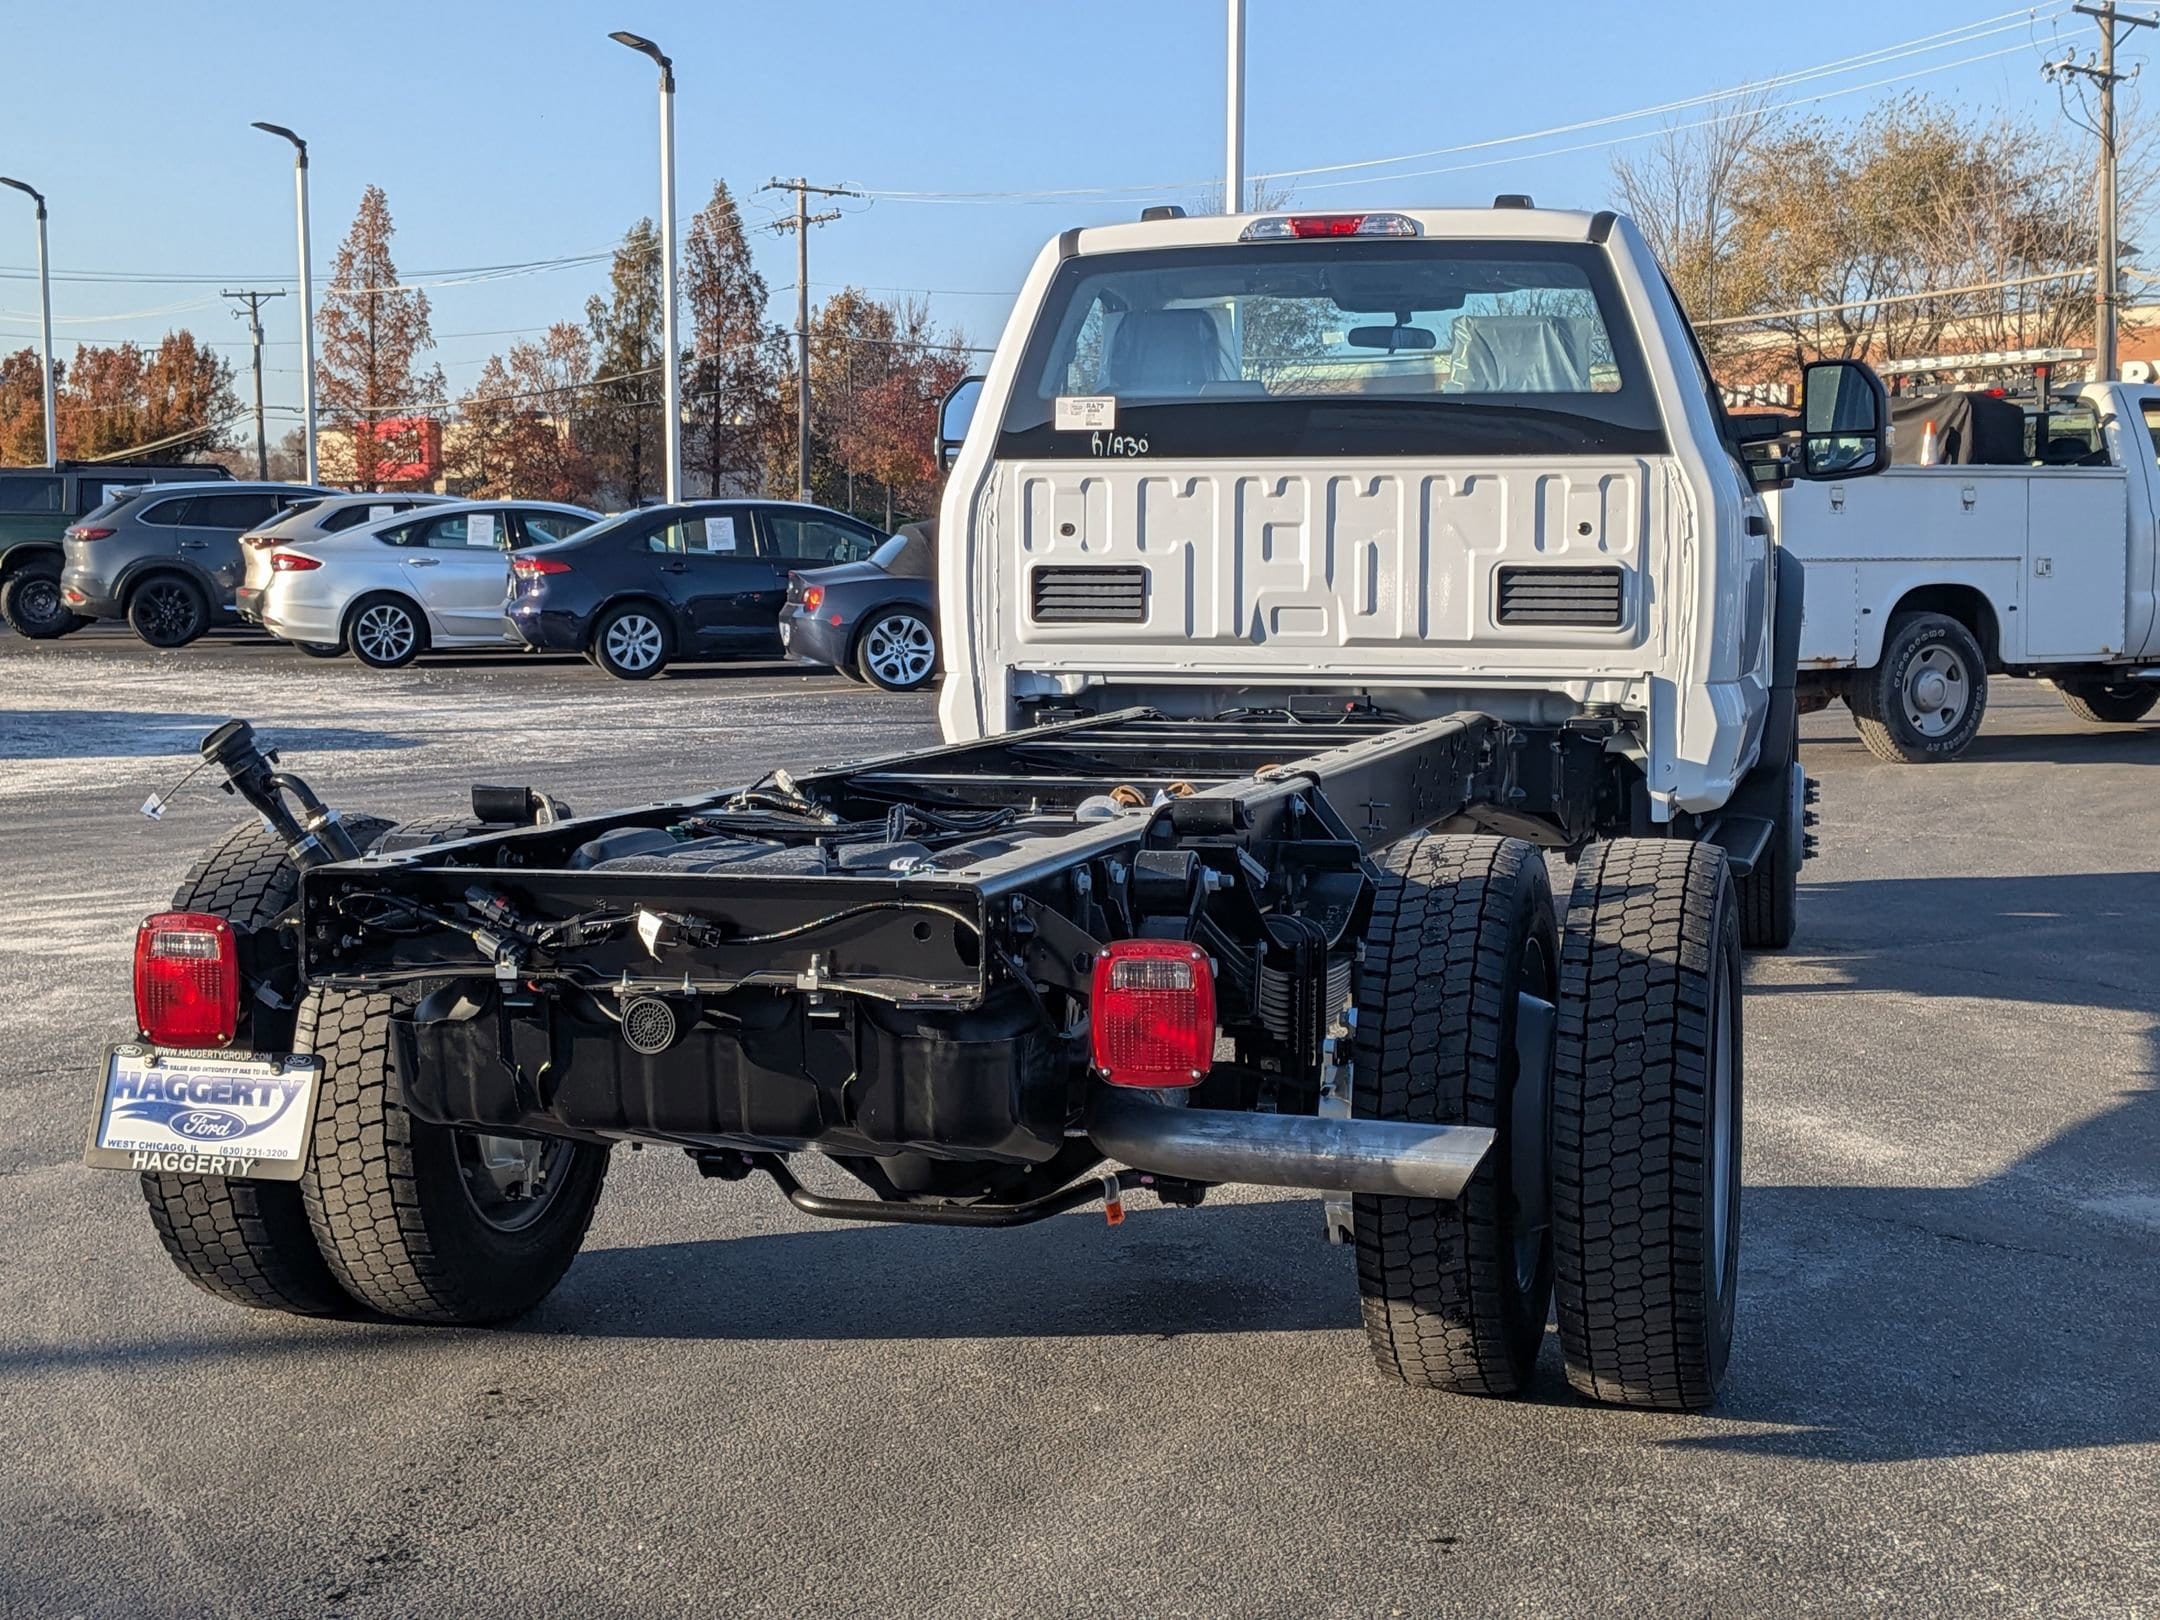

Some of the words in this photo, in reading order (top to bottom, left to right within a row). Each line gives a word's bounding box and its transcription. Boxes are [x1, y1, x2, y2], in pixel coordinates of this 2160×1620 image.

[154, 1046, 273, 1063] WWW.HAGGERTYGROUP.COM
[114, 1071, 305, 1107] HAGGERTY
[183, 1113, 232, 1136] Ford
[107, 1139, 136, 1149] WEST
[139, 1141, 187, 1153] CHICAGO,
[190, 1144, 199, 1153] IL
[219, 1146, 243, 1157] (630)
[132, 1150, 255, 1177] HAGGERTY
